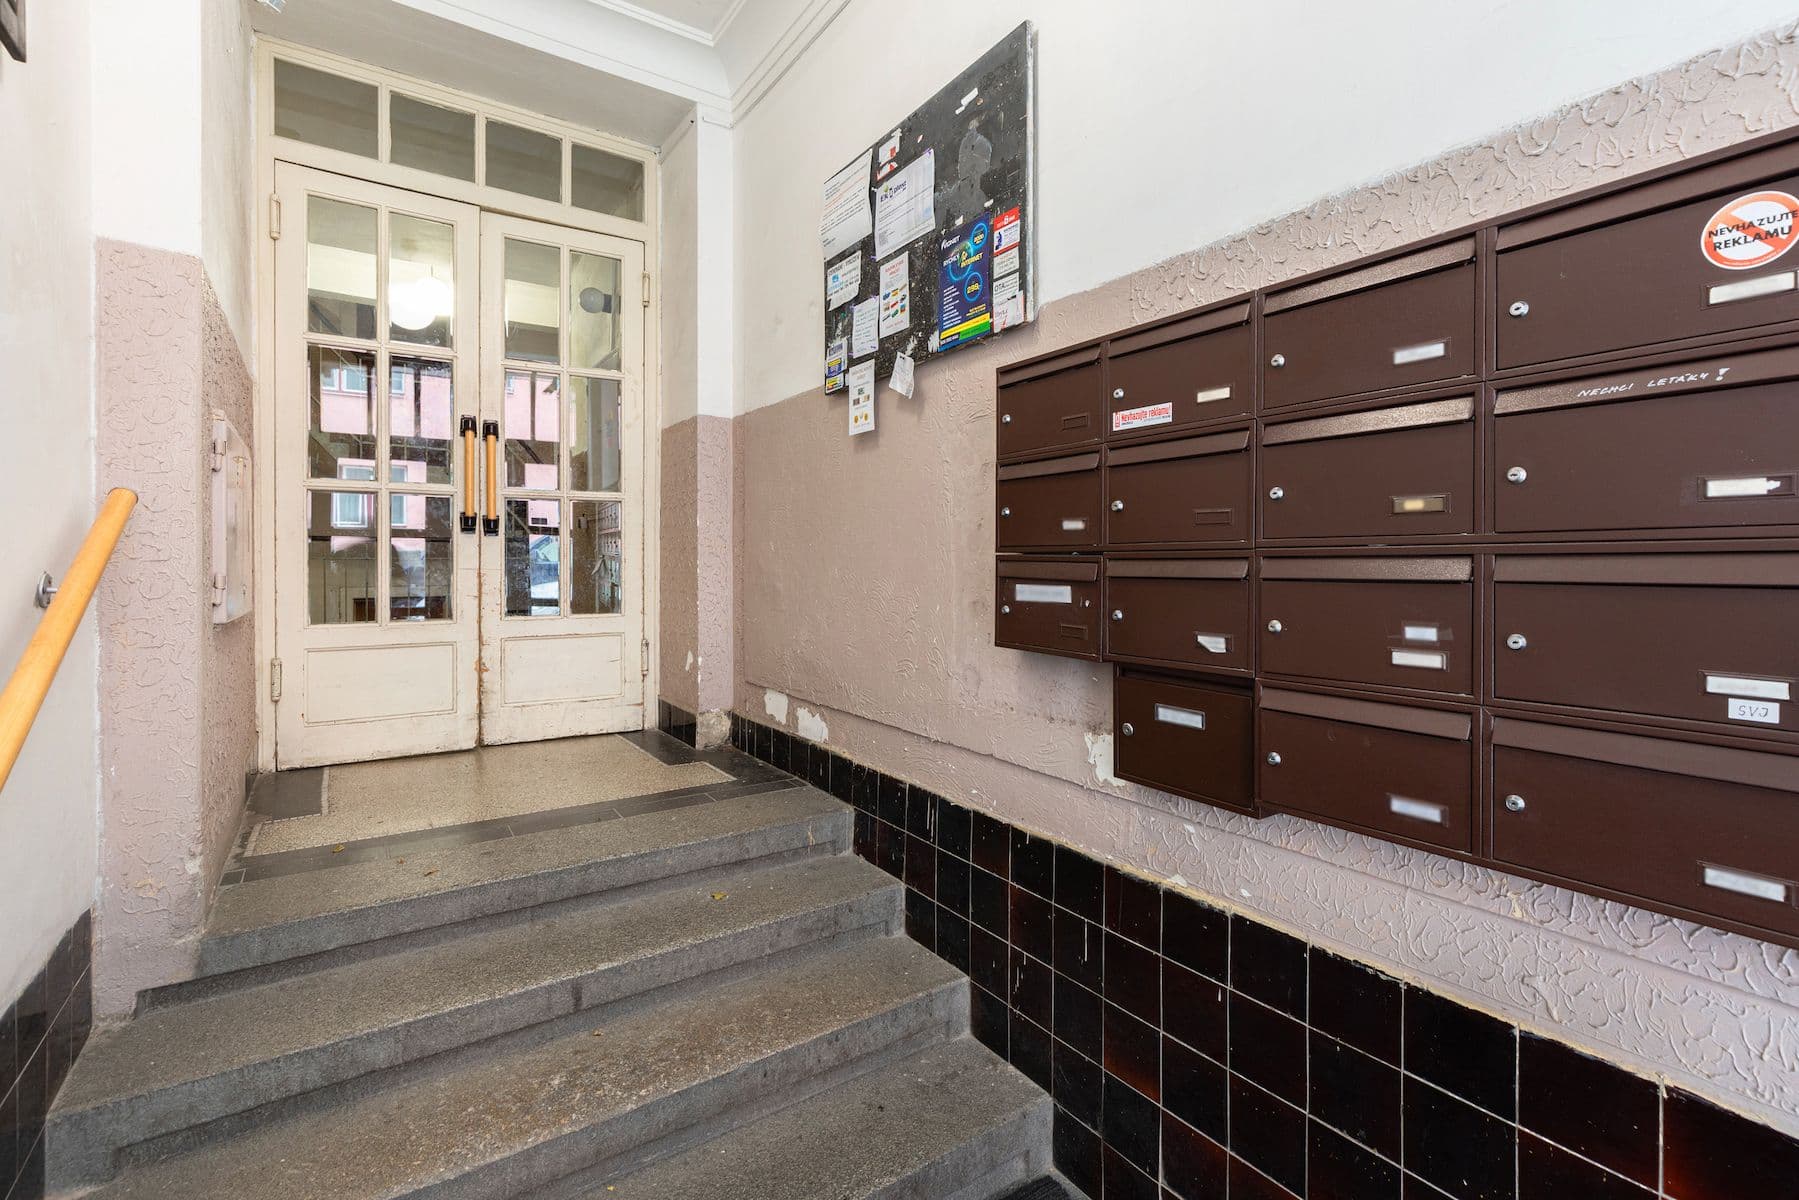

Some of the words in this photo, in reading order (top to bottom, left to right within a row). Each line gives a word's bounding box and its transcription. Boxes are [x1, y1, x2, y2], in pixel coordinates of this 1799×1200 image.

[1708, 210, 1798, 239] NEVHAZUJTE
[1713, 225, 1792, 252] REKLAMU
[1577, 382, 1634, 398] NECHCI
[1738, 705, 1769, 718] SVJ
